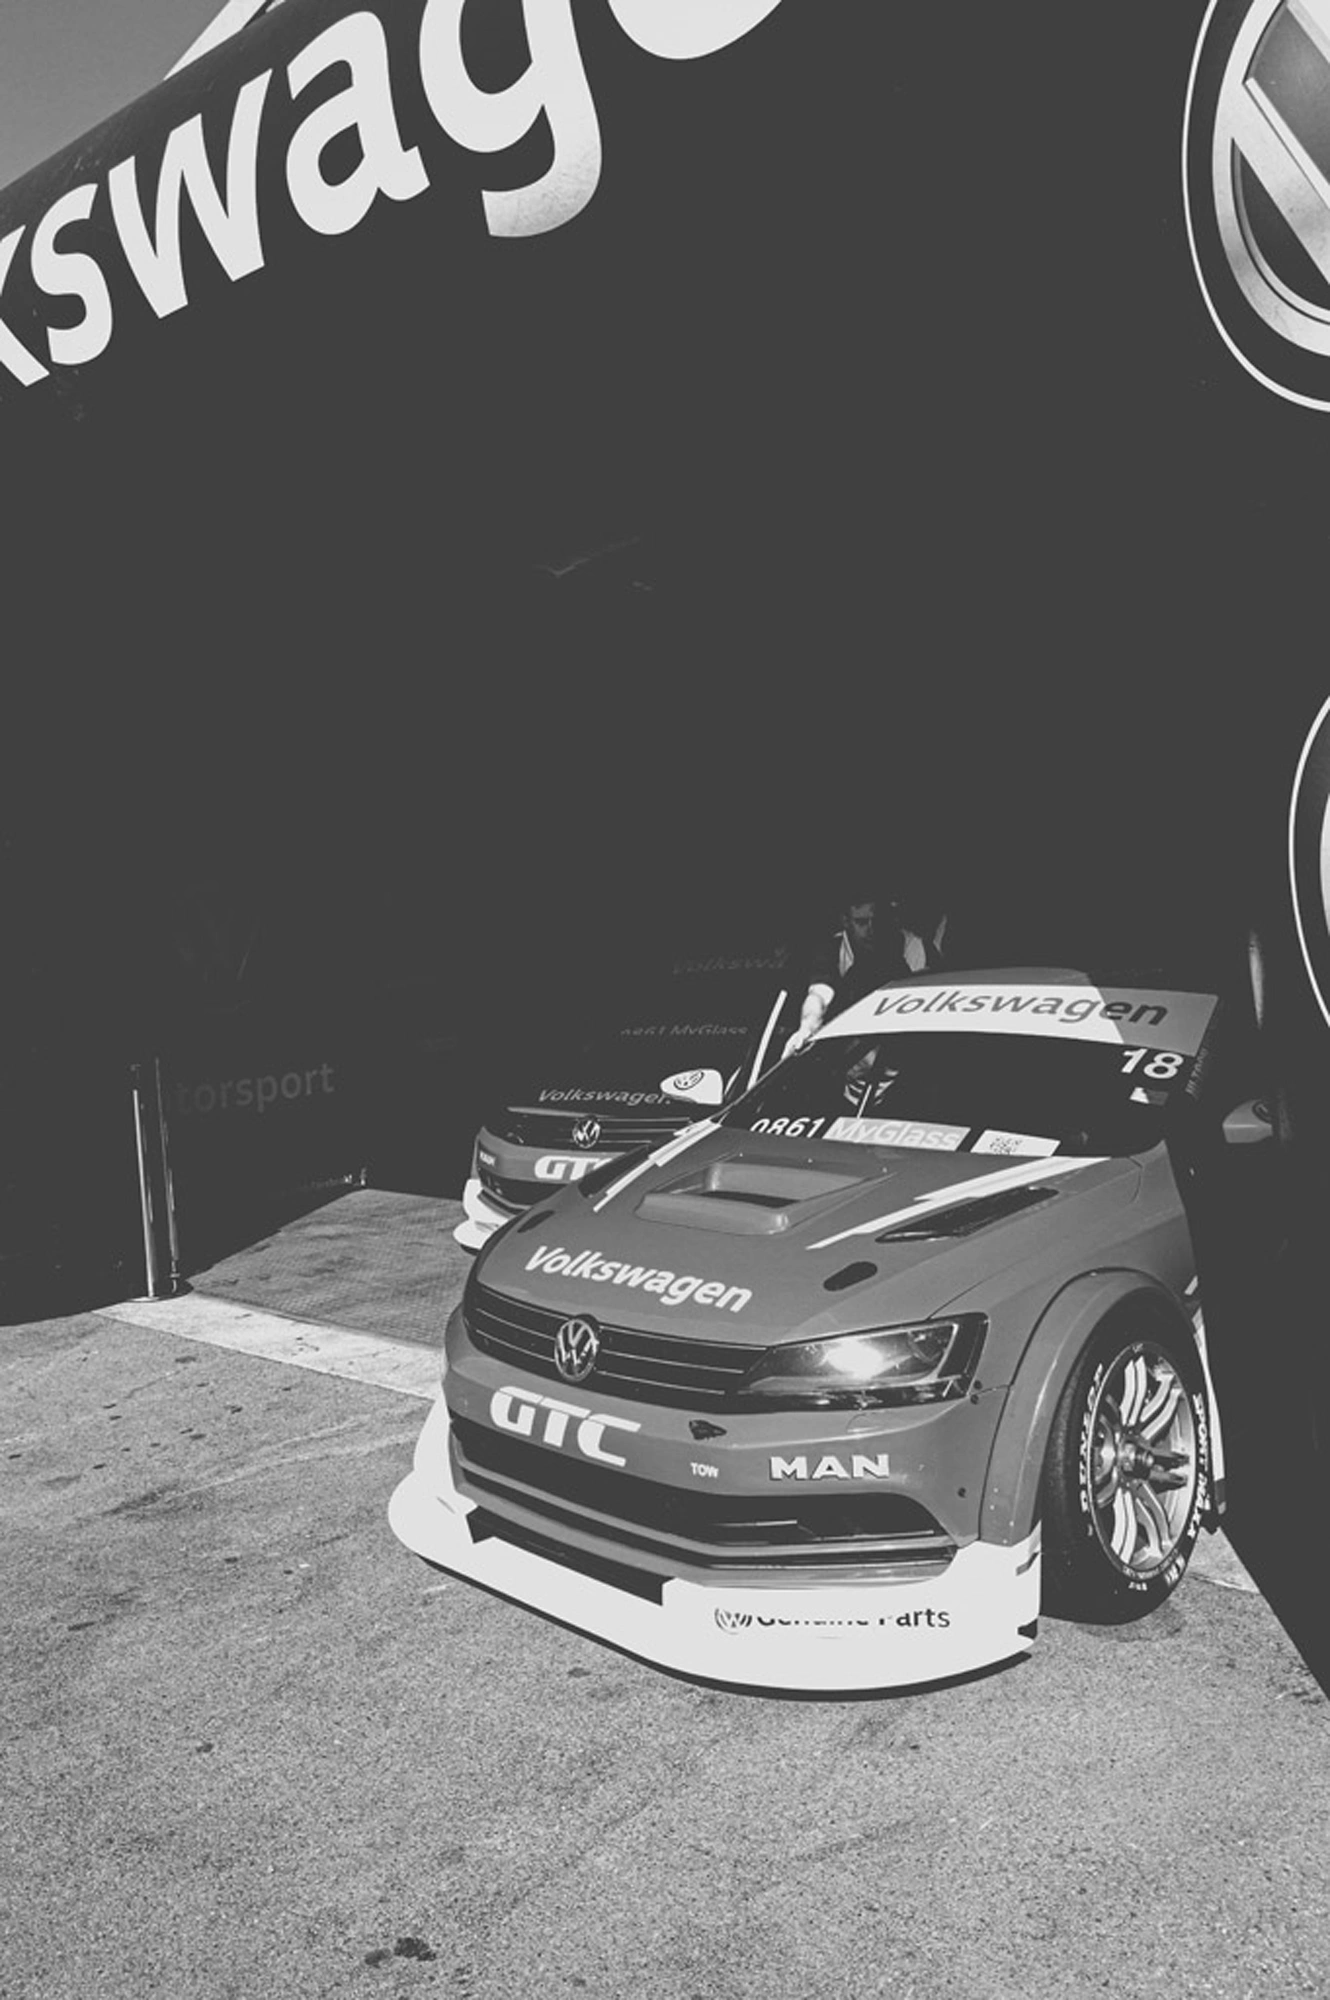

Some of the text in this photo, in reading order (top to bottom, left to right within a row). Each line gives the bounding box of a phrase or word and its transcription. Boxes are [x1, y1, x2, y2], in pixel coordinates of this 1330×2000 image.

[872, 988, 1169, 1026] Volkswagen
[1120, 1048, 1184, 1079] 18
[749, 1116, 826, 1139] 0861
[826, 1119, 961, 1149] MyGlass
[524, 1245, 753, 1313] Volkswagen
[490, 1385, 641, 1467] GTC
[690, 1461, 719, 1478] TOW
[770, 1454, 891, 1480] MAN
